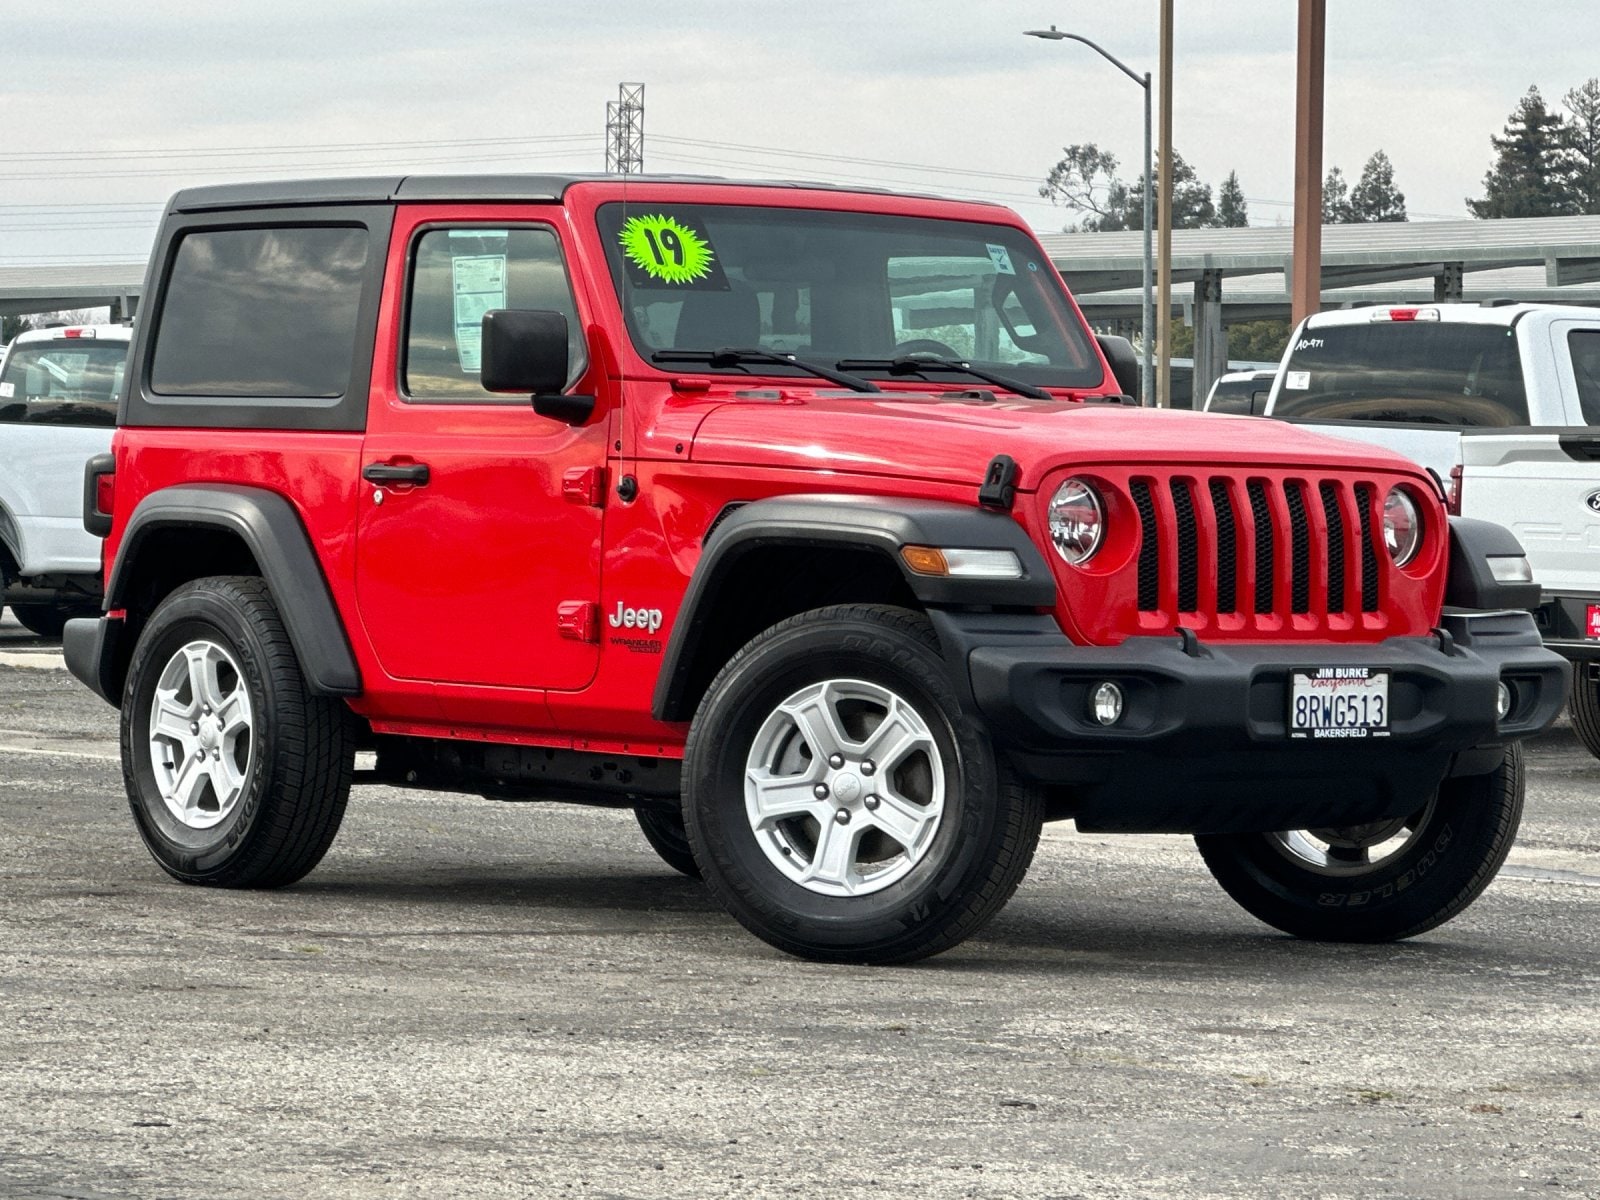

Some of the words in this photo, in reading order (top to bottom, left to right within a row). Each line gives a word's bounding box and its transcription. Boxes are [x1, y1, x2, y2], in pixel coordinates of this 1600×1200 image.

[643, 228, 686, 268] 19
[608, 601, 662, 634] Jeep
[1316, 668, 1334, 678] JIM
[1335, 668, 1369, 678] BURKE
[1296, 694, 1384, 727] 8RWG513
[1314, 728, 1367, 738] BAKERSFIELD
